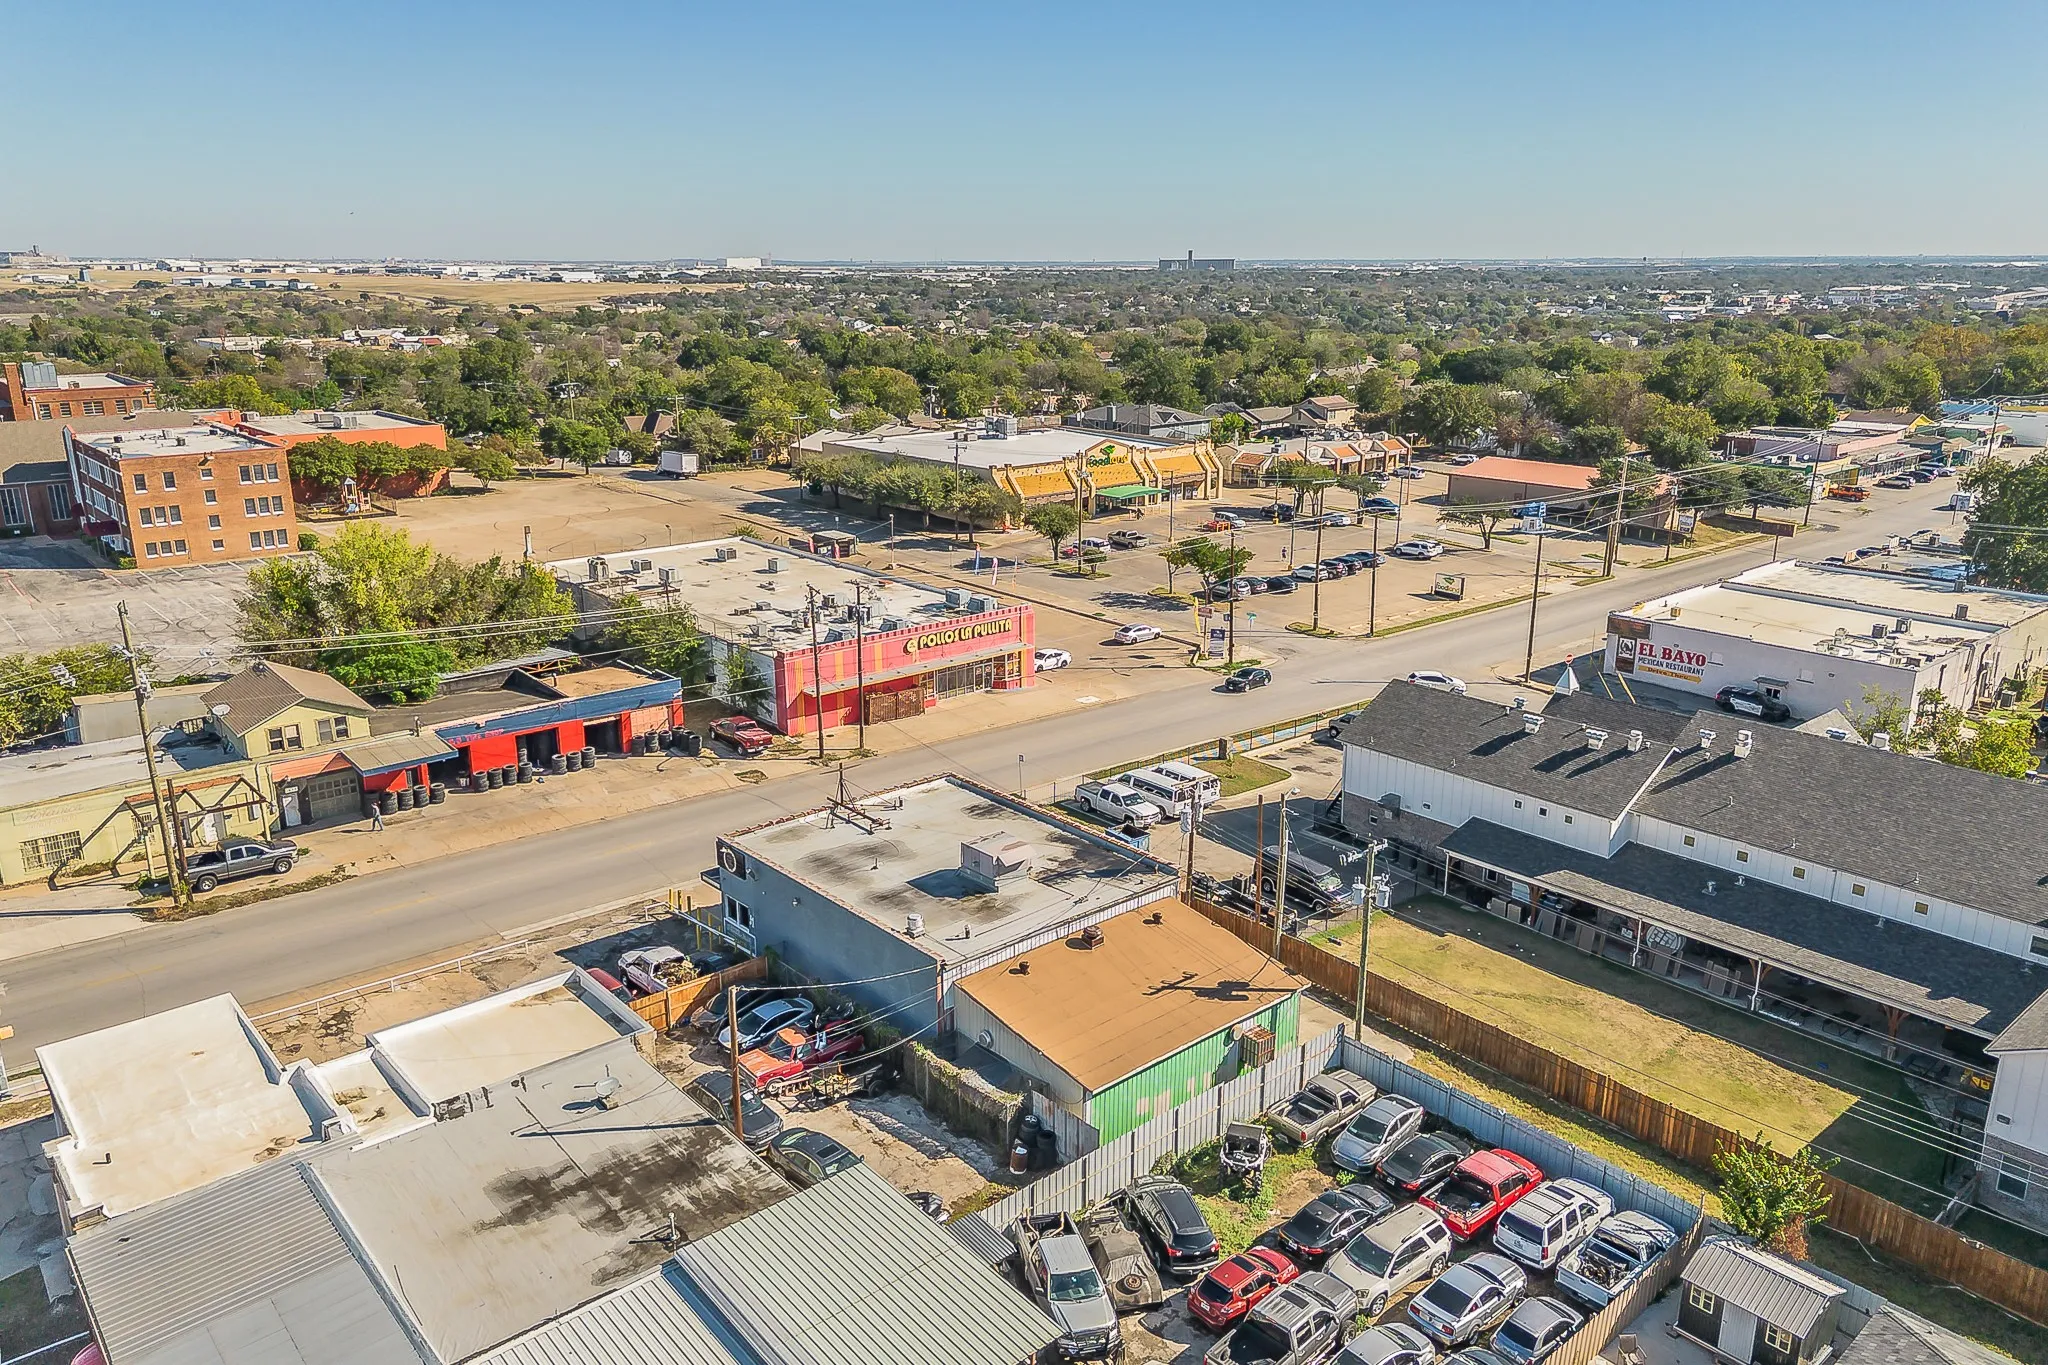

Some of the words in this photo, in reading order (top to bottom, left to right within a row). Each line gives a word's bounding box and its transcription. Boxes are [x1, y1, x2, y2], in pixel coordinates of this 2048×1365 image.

[919, 626, 960, 649] POLLOS
[960, 626, 973, 640] LA
[973, 618, 1012, 637] PULLITA
[1639, 642, 1657, 658] EL
[1661, 646, 1706, 666] BAYO
[1638, 657, 1664, 668] MEXICAN
[1665, 661, 1705, 676] RESTAURANT
